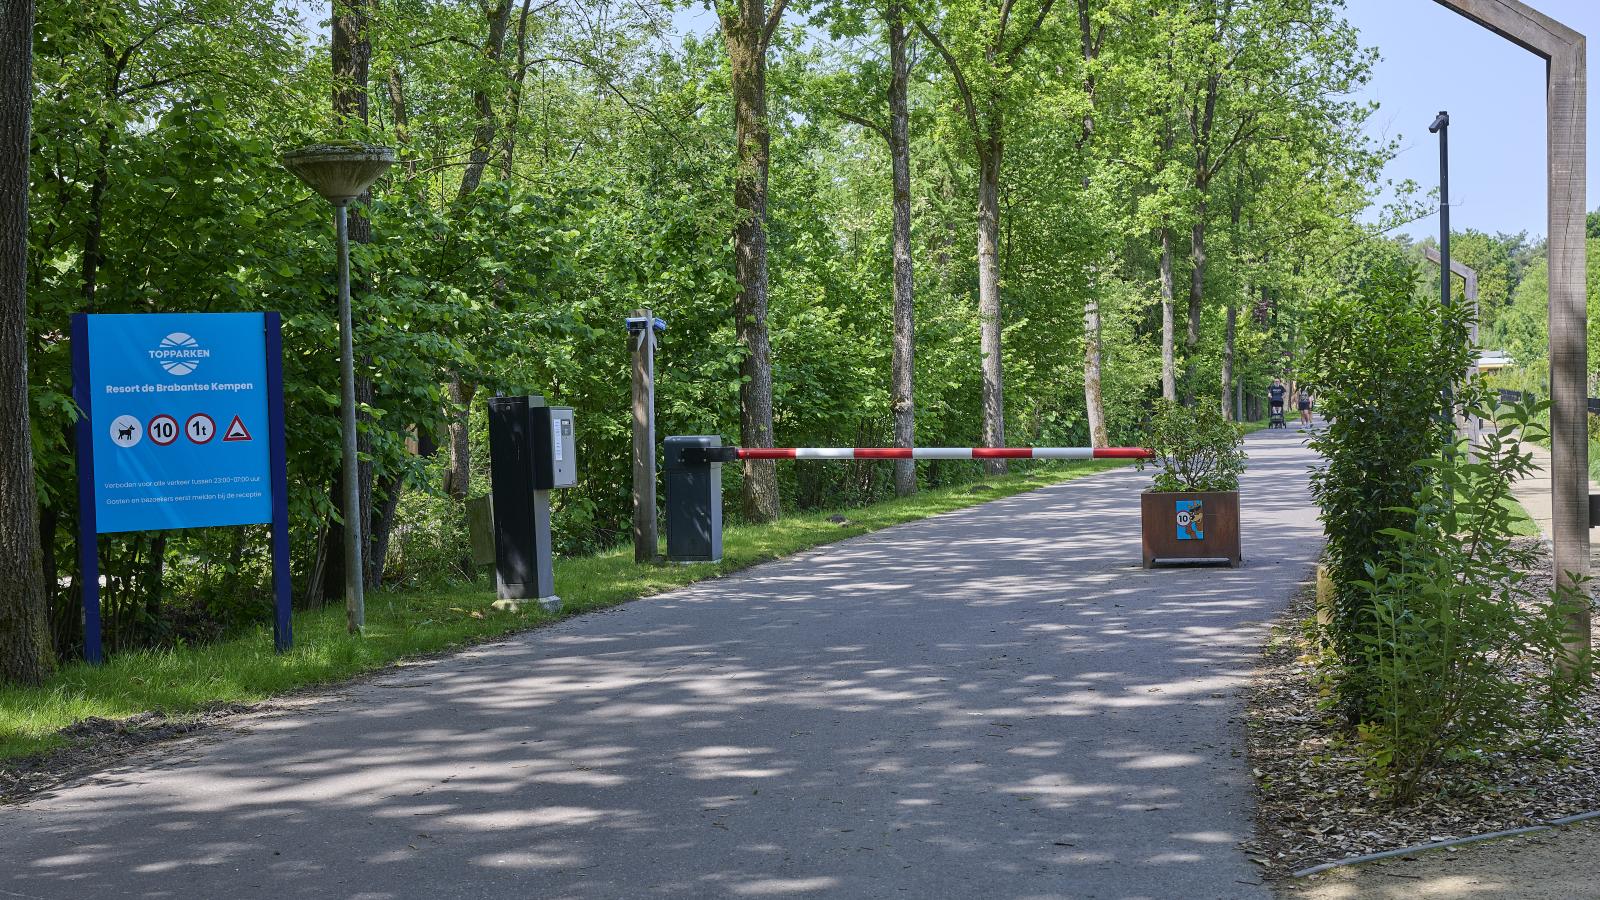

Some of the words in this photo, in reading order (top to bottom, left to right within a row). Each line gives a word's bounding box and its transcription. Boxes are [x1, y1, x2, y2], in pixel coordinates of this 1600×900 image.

[149, 350, 210, 358] TOPPARKEN
[106, 385, 140, 393] Resort
[142, 384, 155, 392] de
[156, 384, 210, 392] Brabantse
[211, 382, 253, 392] Kempen
[154, 423, 172, 437] 10
[193, 421, 206, 436] 1t
